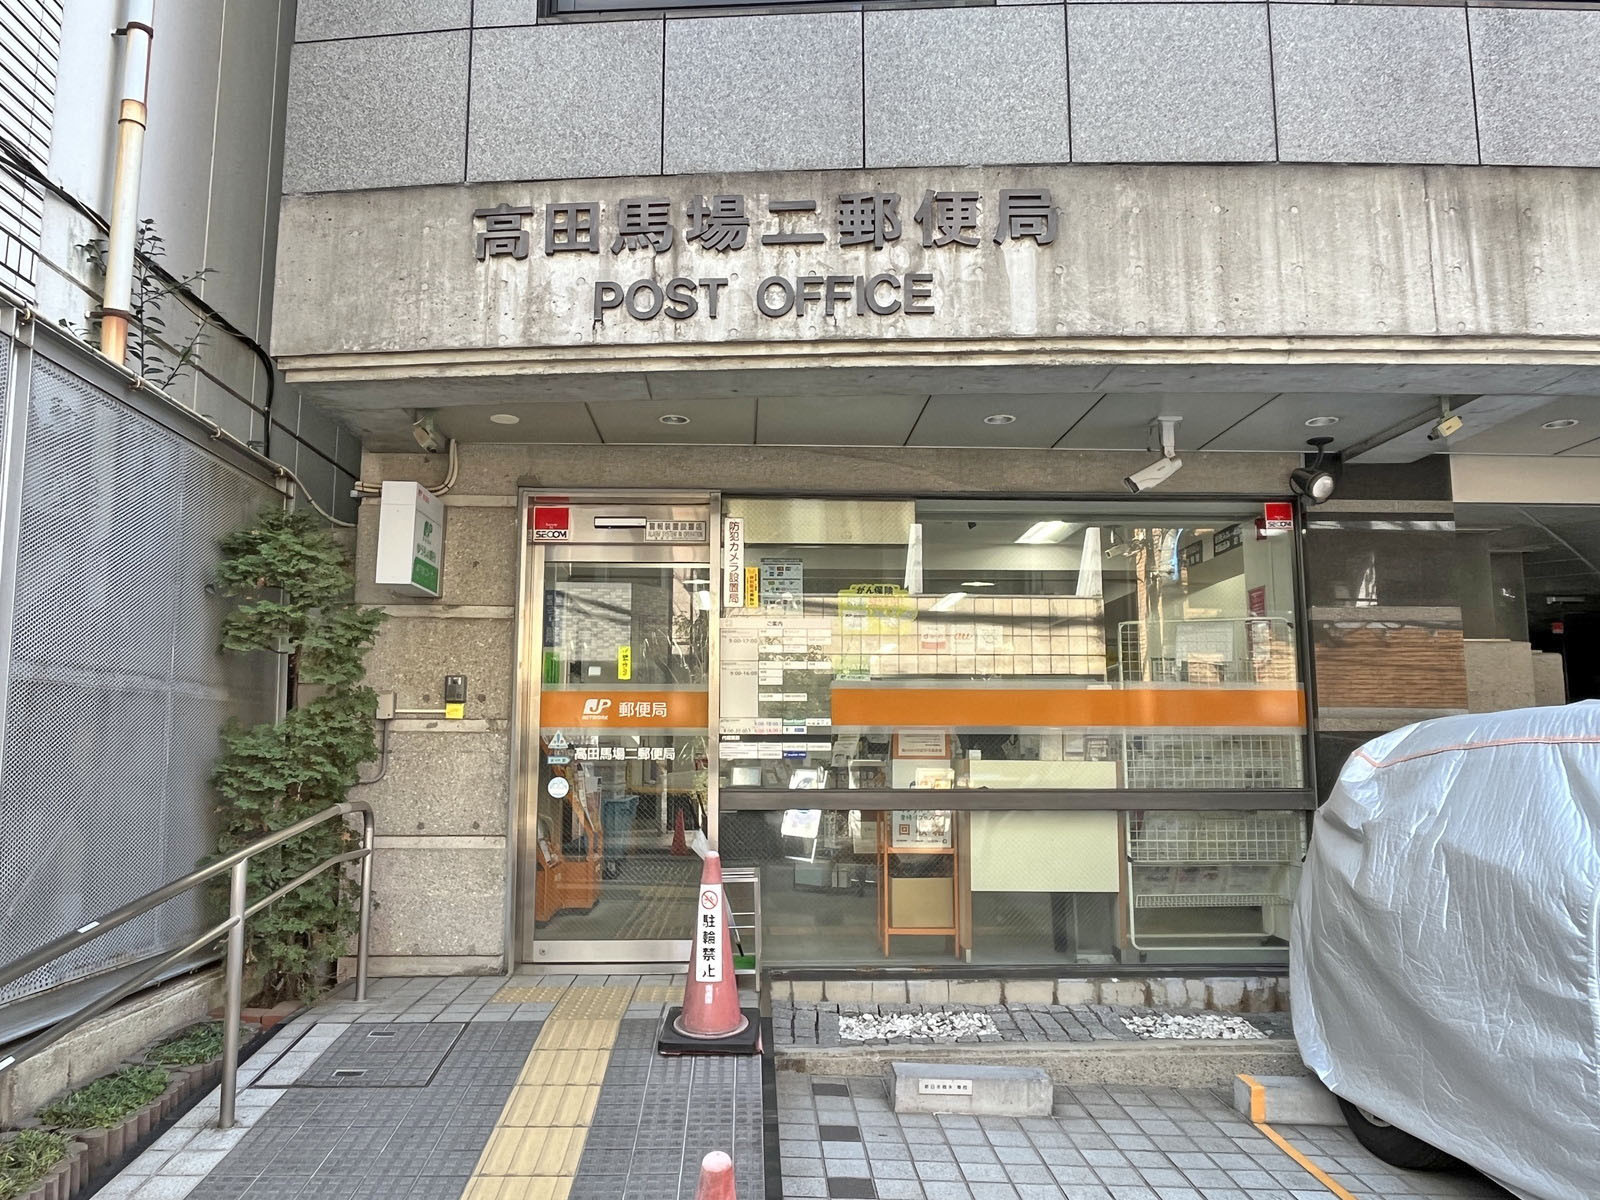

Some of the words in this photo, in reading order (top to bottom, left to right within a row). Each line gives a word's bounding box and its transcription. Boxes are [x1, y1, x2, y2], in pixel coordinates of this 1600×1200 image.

[474, 188, 1059, 261] 高田馬場二郵便局
[593, 277, 729, 321] POST
[755, 272, 936, 319] OFFICE
[536, 530, 567, 539] SECOM
[728, 521, 740, 604] 防犯カメラ設置局
[583, 699, 611, 714] JP
[618, 702, 667, 717] 郵便局
[574, 747, 676, 761] 高田馬場二郵便局
[702, 914, 716, 978] 駐輪禁止
